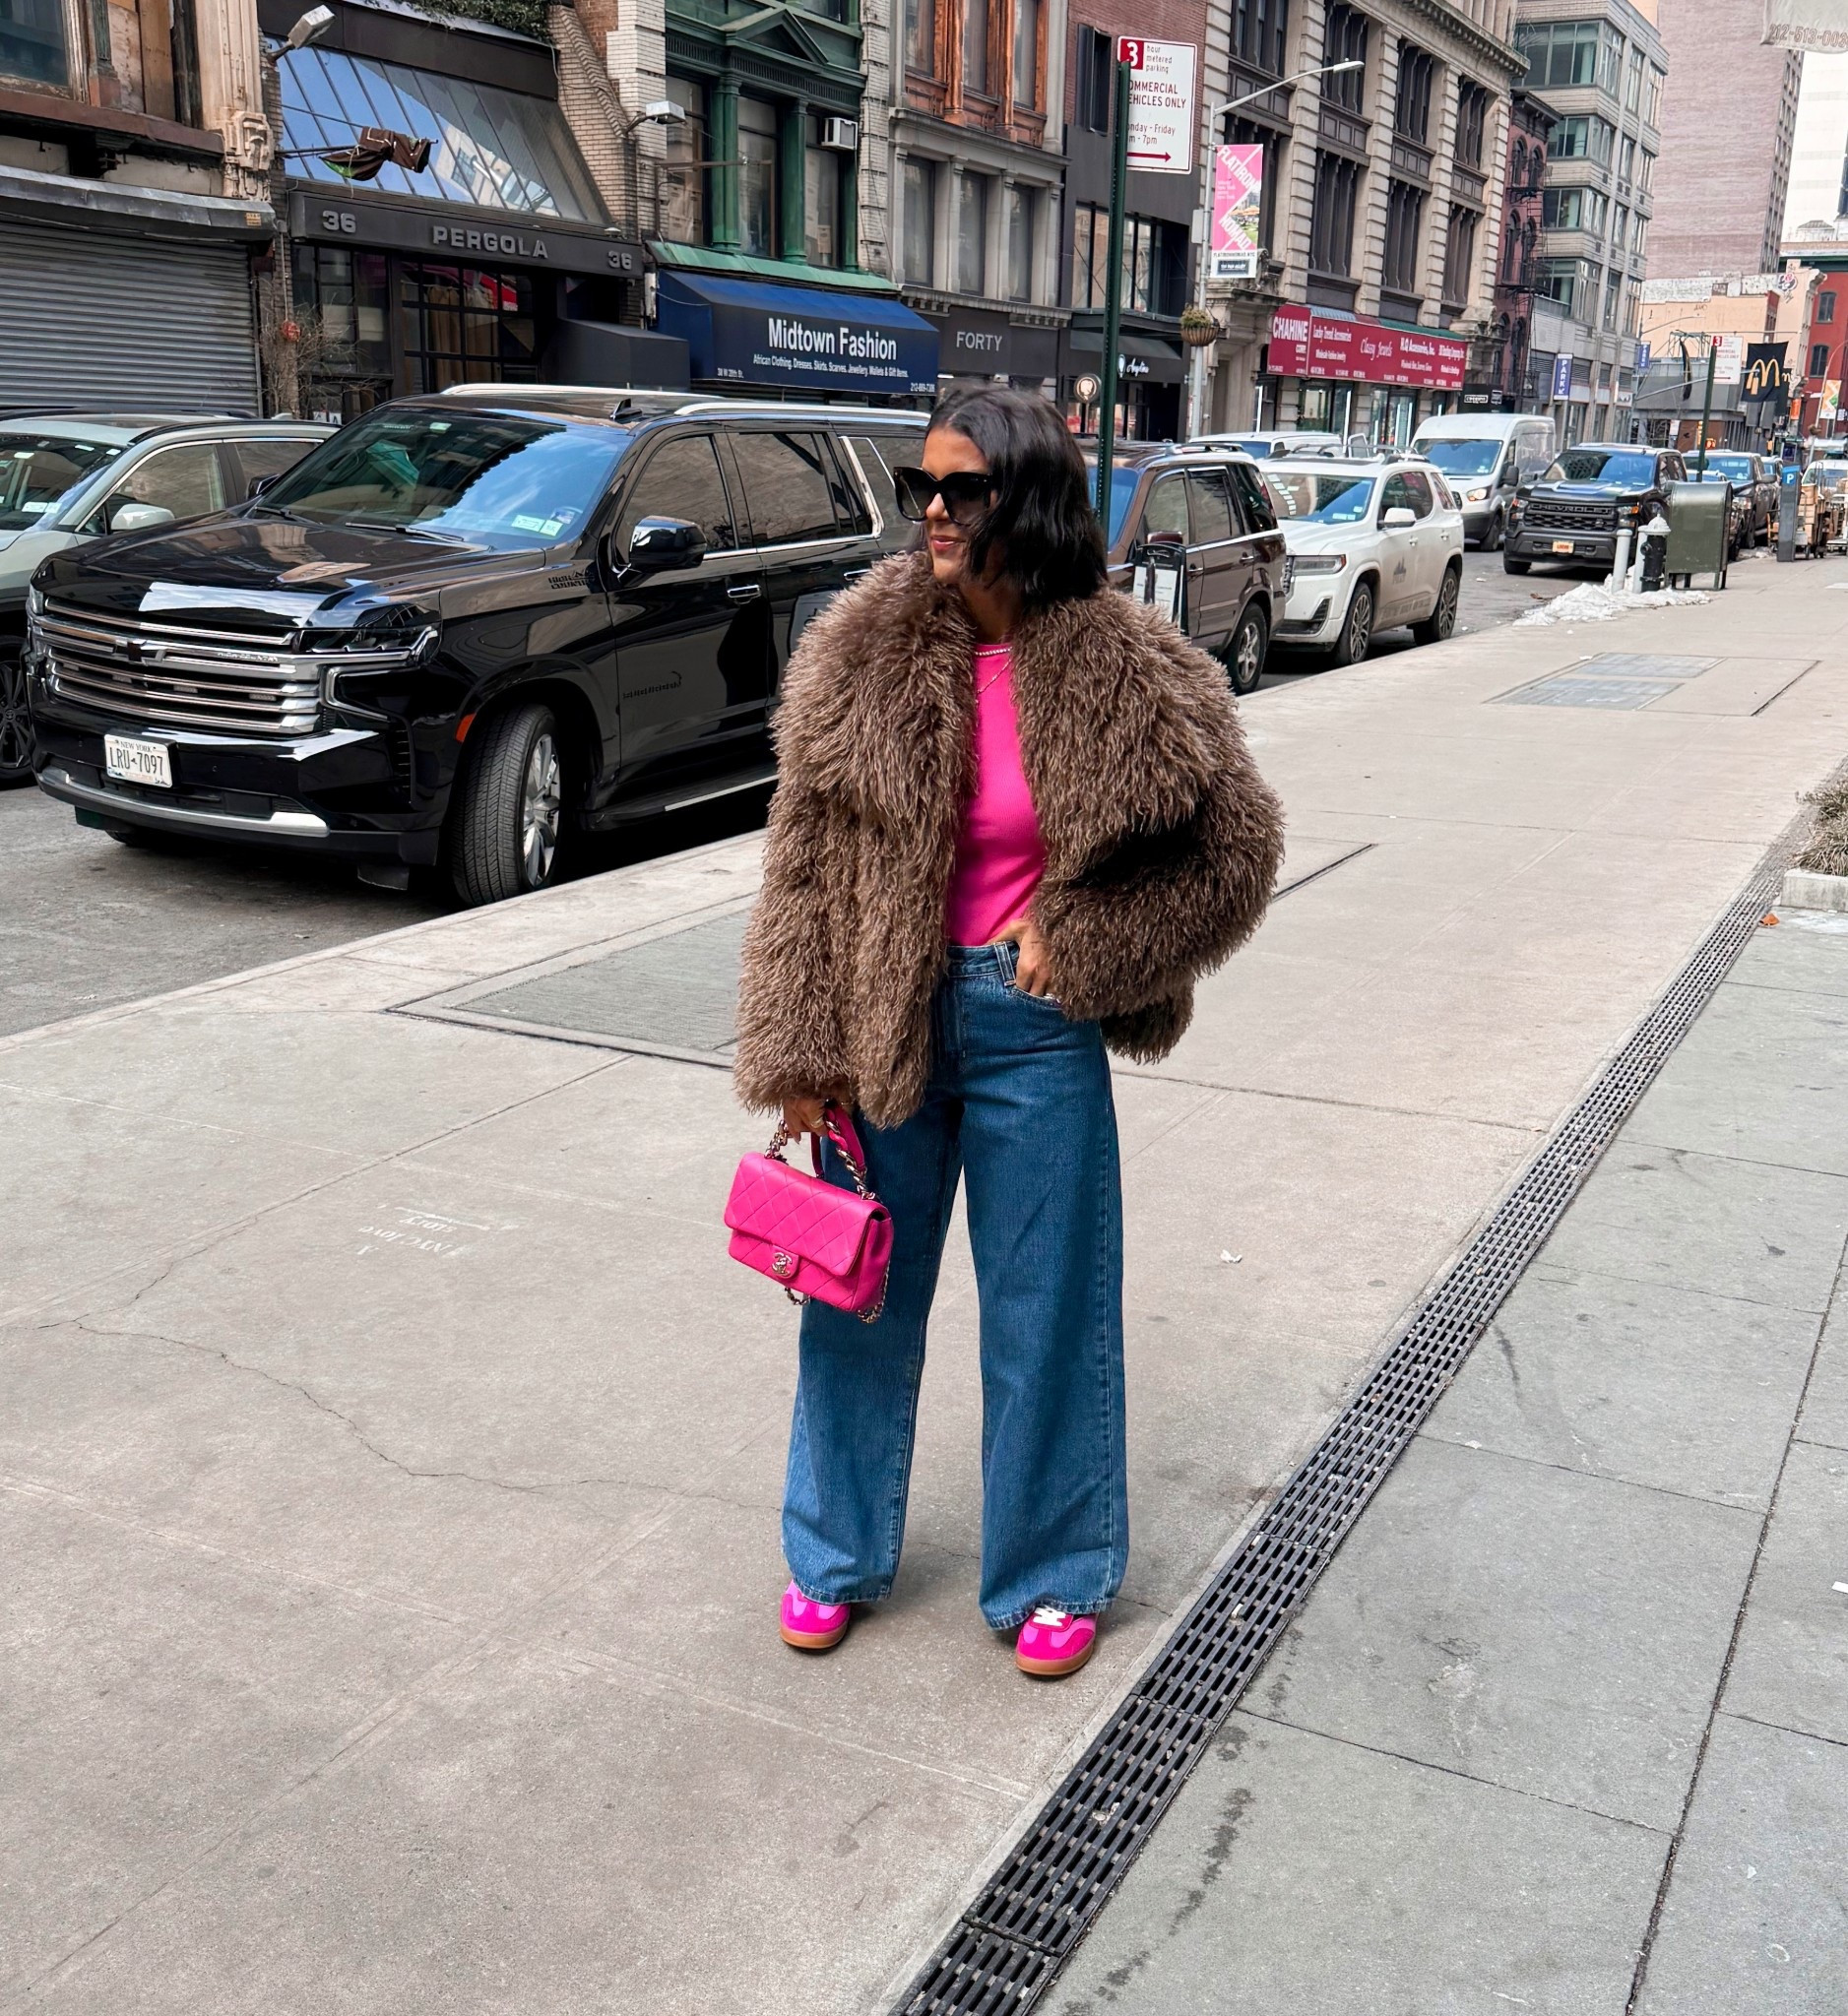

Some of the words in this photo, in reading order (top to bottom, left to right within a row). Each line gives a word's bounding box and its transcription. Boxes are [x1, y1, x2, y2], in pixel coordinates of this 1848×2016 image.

[1126, 41, 1138, 67] 3
[1146, 44, 1161, 53] hour
[1146, 54, 1173, 64] metered
[1146, 64, 1169, 74] parking
[1129, 81, 1179, 94] OMMERCIAL
[1129, 94, 1163, 106] EHICLES
[1165, 96, 1186, 109] ONLY
[1127, 122, 1147, 133] onday
[1154, 123, 1176, 136] Friday
[1143, 135, 1158, 146] 7pm
[323, 210, 356, 233] 36
[1218, 216, 1252, 250] NOMAD
[432, 225, 548, 259] PERGOLA
[607, 250, 633, 271] 36
[1273, 316, 1308, 342] CHAHINE
[768, 317, 835, 354] Midtown
[839, 327, 897, 360] Fashion
[956, 331, 1002, 351] FORTY
[1714, 336, 1721, 346] 3
[1559, 359, 1567, 388] PARK
[1786, 473, 1794, 483] P
[1528, 503, 1613, 514] CHEVROLET
[135, 743, 153, 753] YORK
